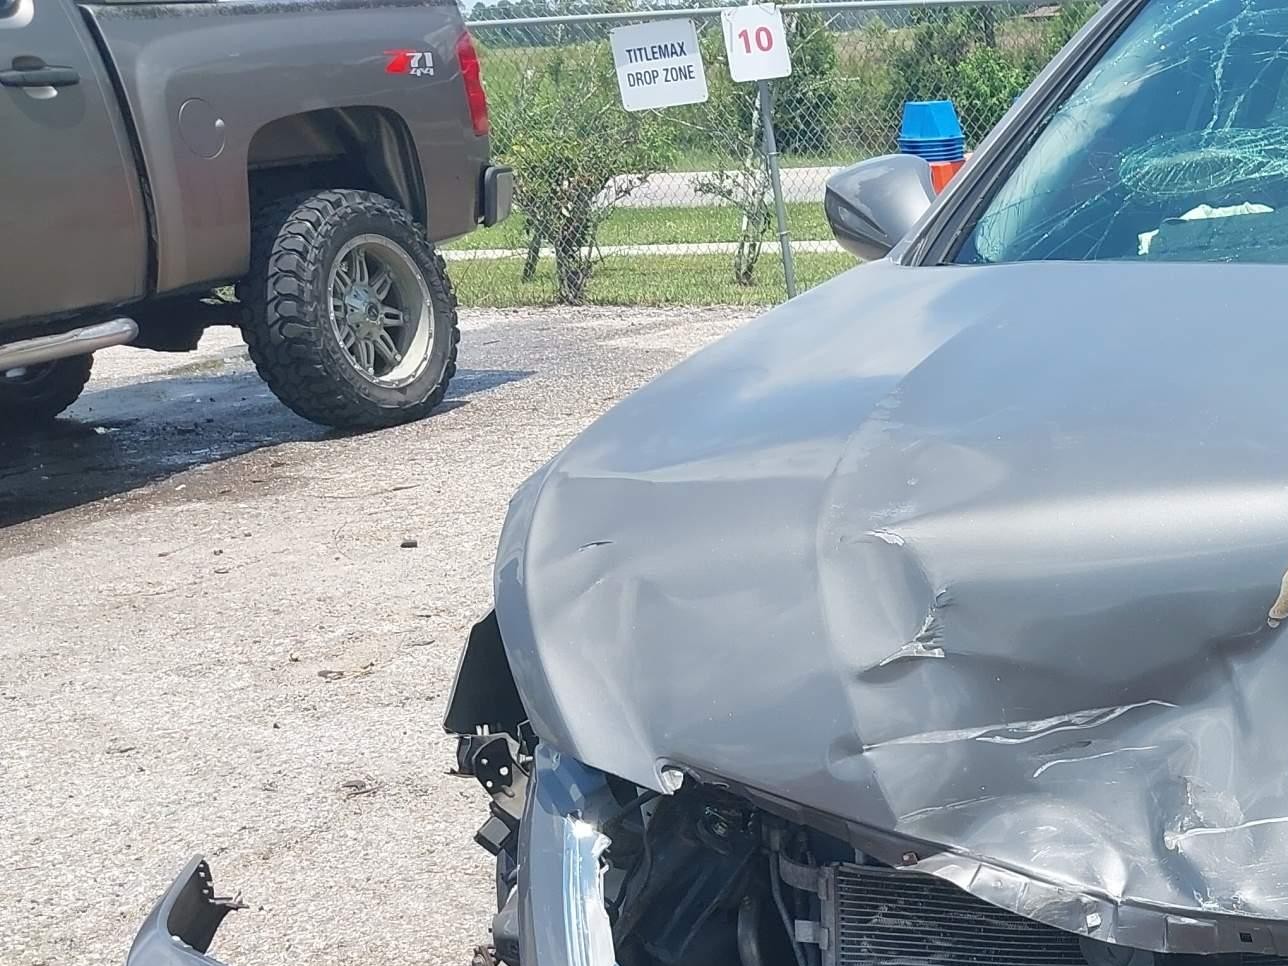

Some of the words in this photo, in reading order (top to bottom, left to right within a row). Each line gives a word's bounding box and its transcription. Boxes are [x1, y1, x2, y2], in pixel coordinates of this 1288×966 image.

[738, 26, 774, 54] 10
[626, 41, 688, 64] TITLEMAX
[627, 69, 660, 88] DROP
[663, 64, 696, 83] ZONE
